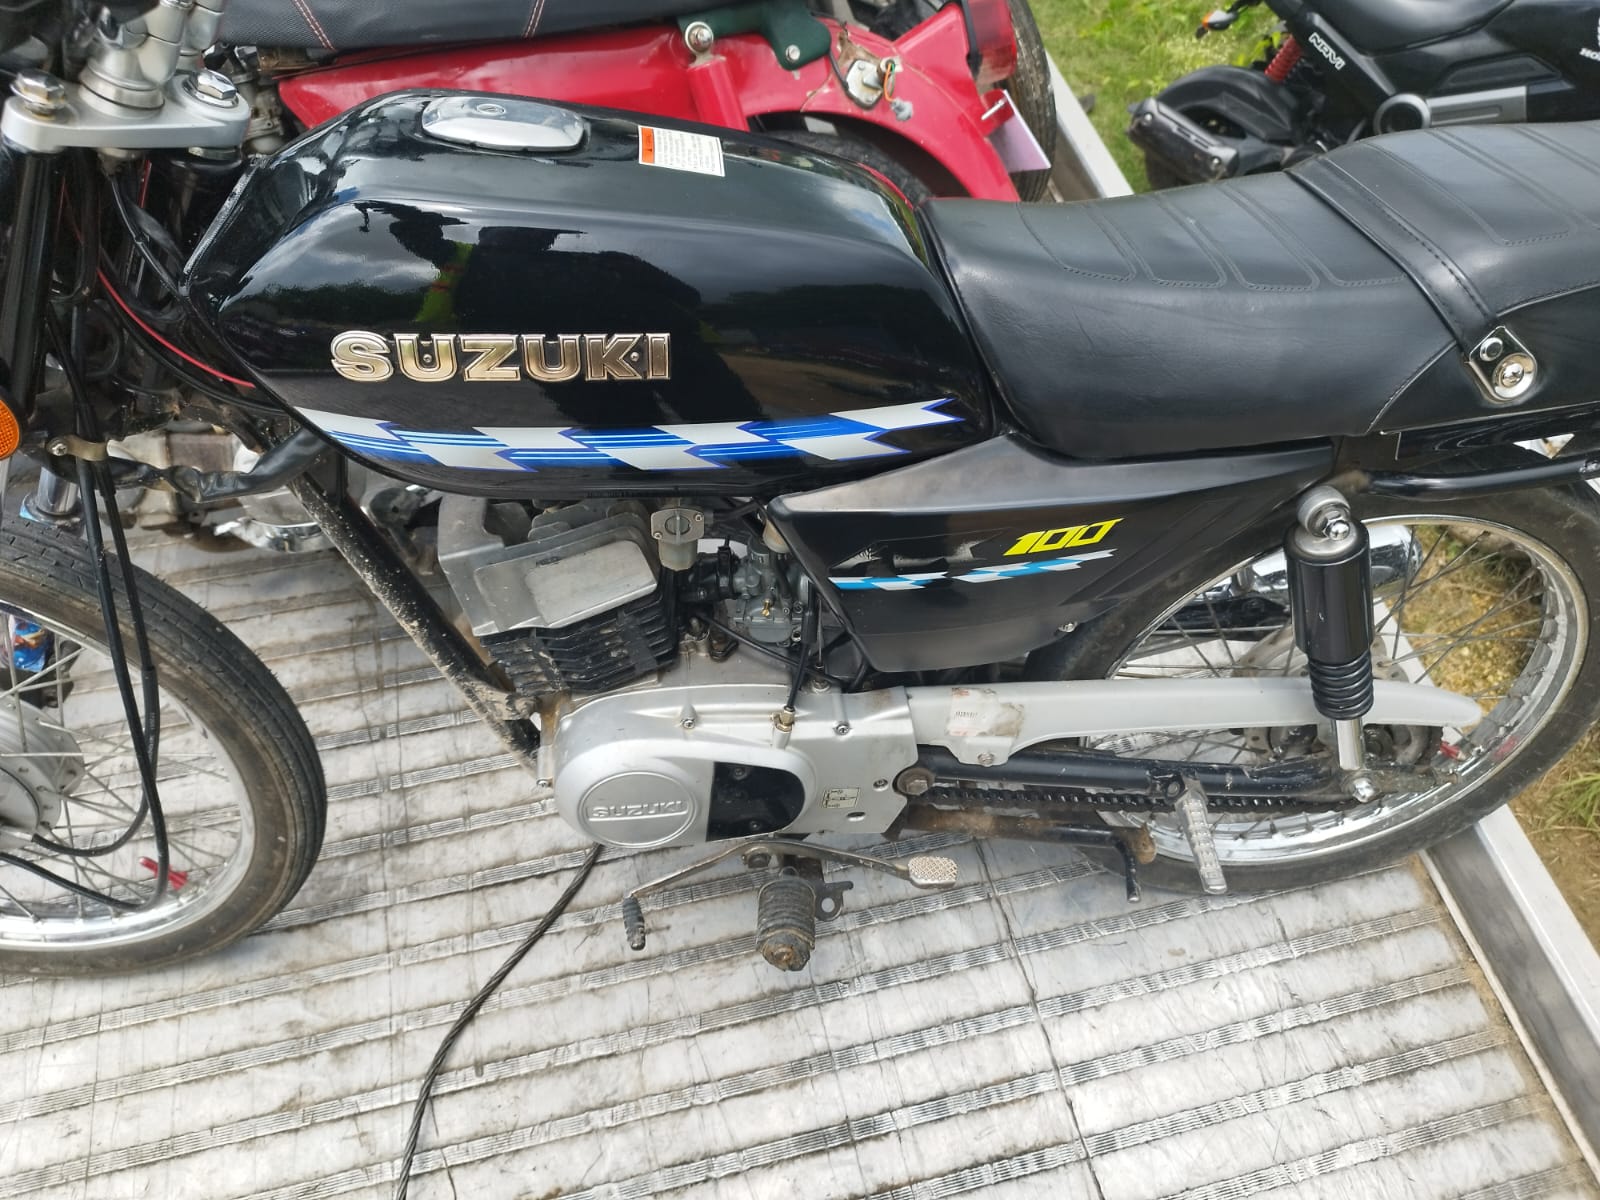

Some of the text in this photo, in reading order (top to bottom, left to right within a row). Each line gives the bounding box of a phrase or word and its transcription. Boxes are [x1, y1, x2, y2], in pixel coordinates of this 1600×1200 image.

[1308, 31, 1346, 70] NAVI
[331, 330, 671, 382] SUZUKI
[1002, 518, 1125, 556] 100
[590, 799, 685, 818] SUZUKI
